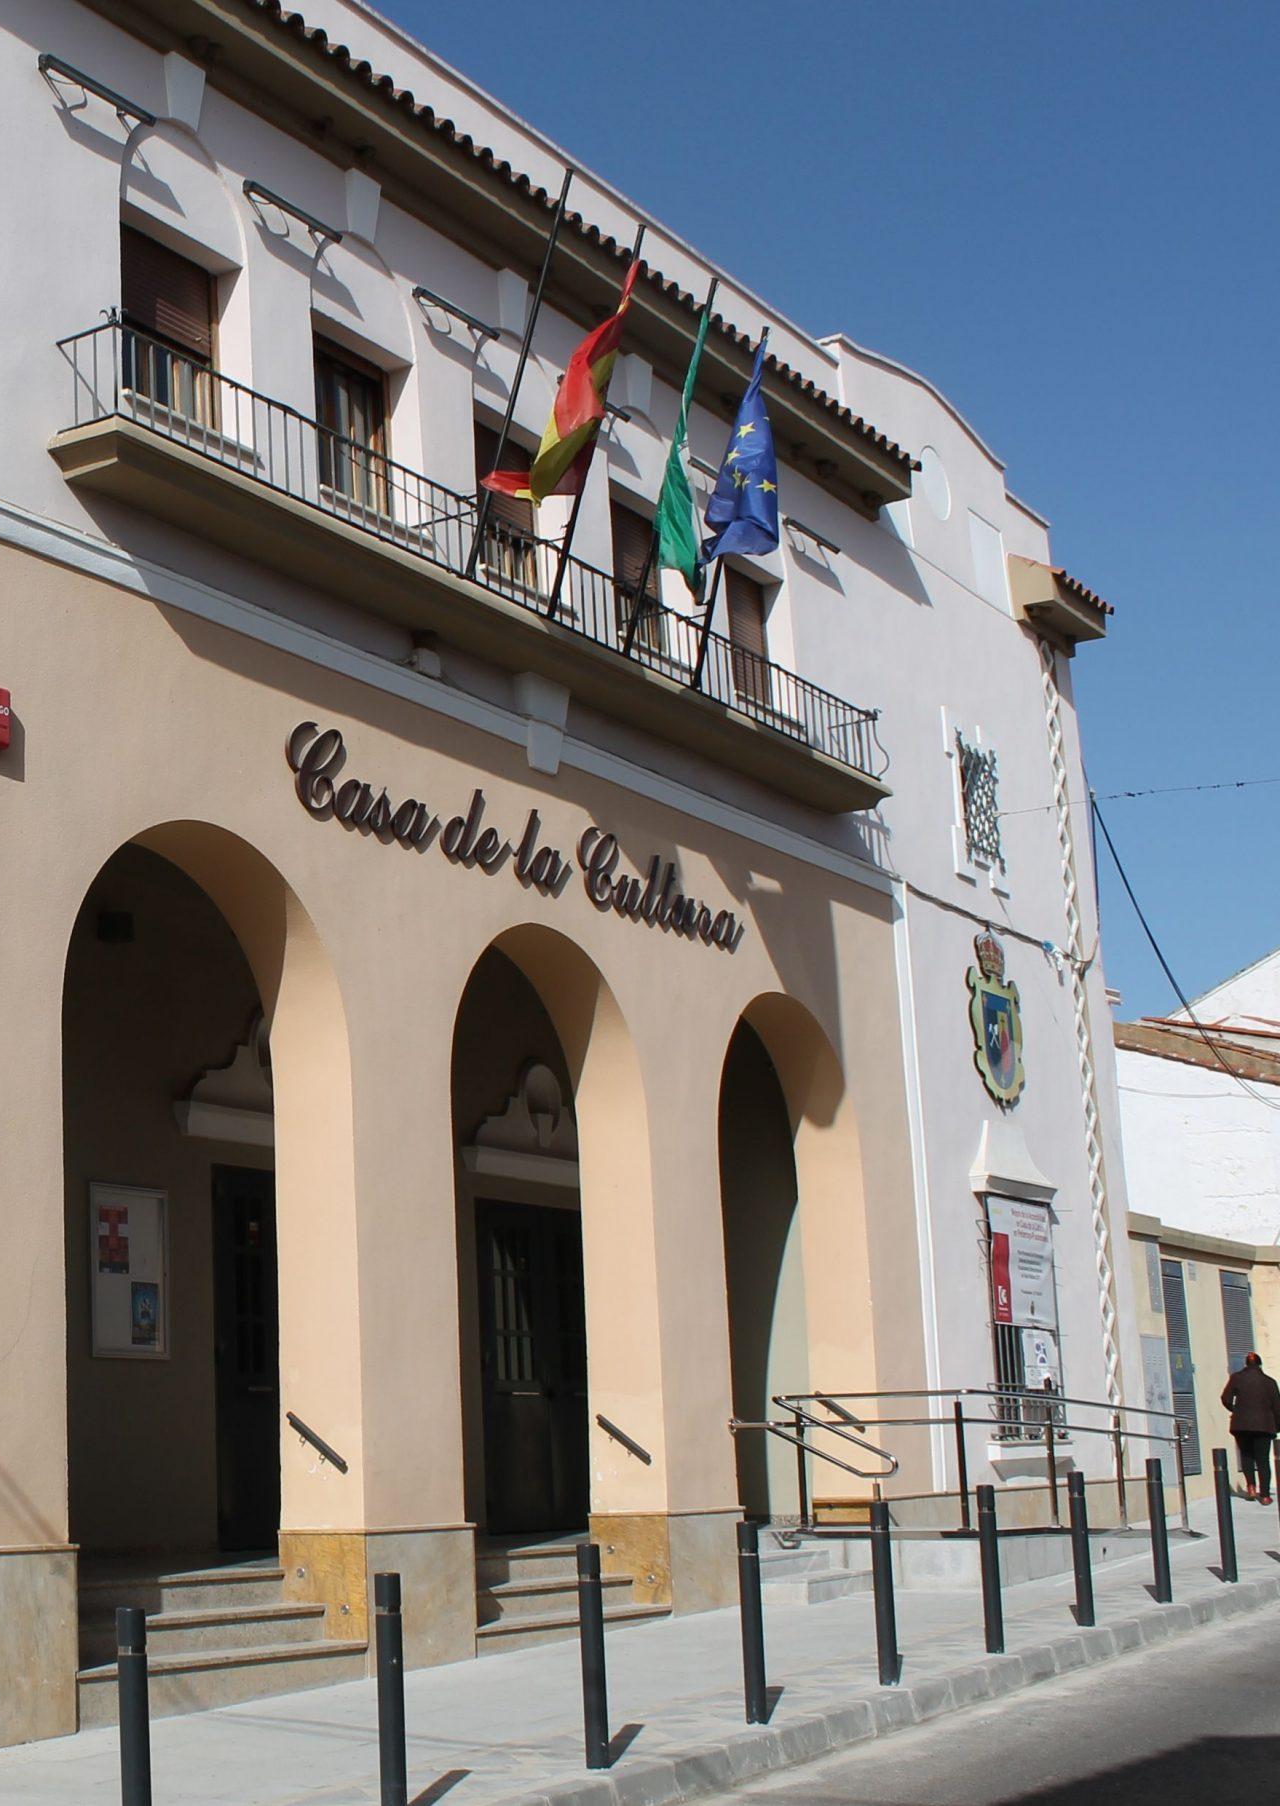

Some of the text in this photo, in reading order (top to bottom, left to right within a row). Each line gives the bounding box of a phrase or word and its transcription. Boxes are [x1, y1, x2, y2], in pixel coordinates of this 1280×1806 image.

[285, 721, 745, 950] Casa de la Cultura
